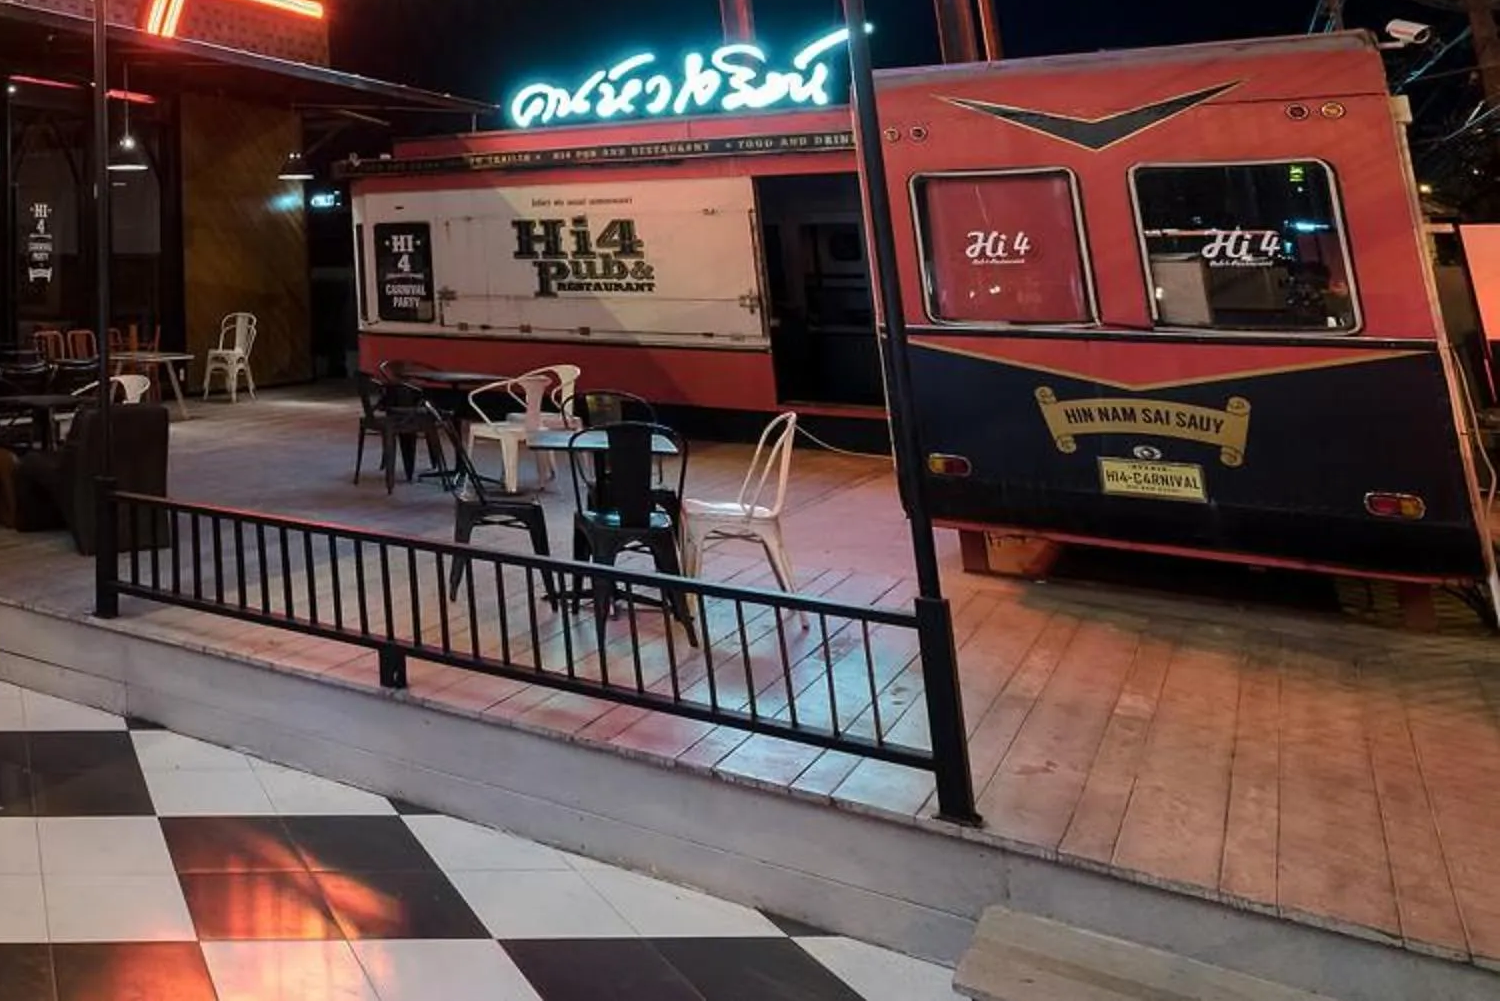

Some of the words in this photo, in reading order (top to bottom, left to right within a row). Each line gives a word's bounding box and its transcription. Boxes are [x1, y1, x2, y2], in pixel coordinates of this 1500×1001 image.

[965, 231, 1008, 258] Hi
[1014, 231, 1031, 255] 4
[1201, 230, 1253, 260] Hi
[1260, 230, 1280, 256] 4
[556, 282, 656, 293] RESTAURANT
[1063, 406, 1094, 425] HIN
[1097, 406, 1137, 424] NAM
[1141, 408, 1171, 426] SAI
[1175, 412, 1225, 434] SAUY
